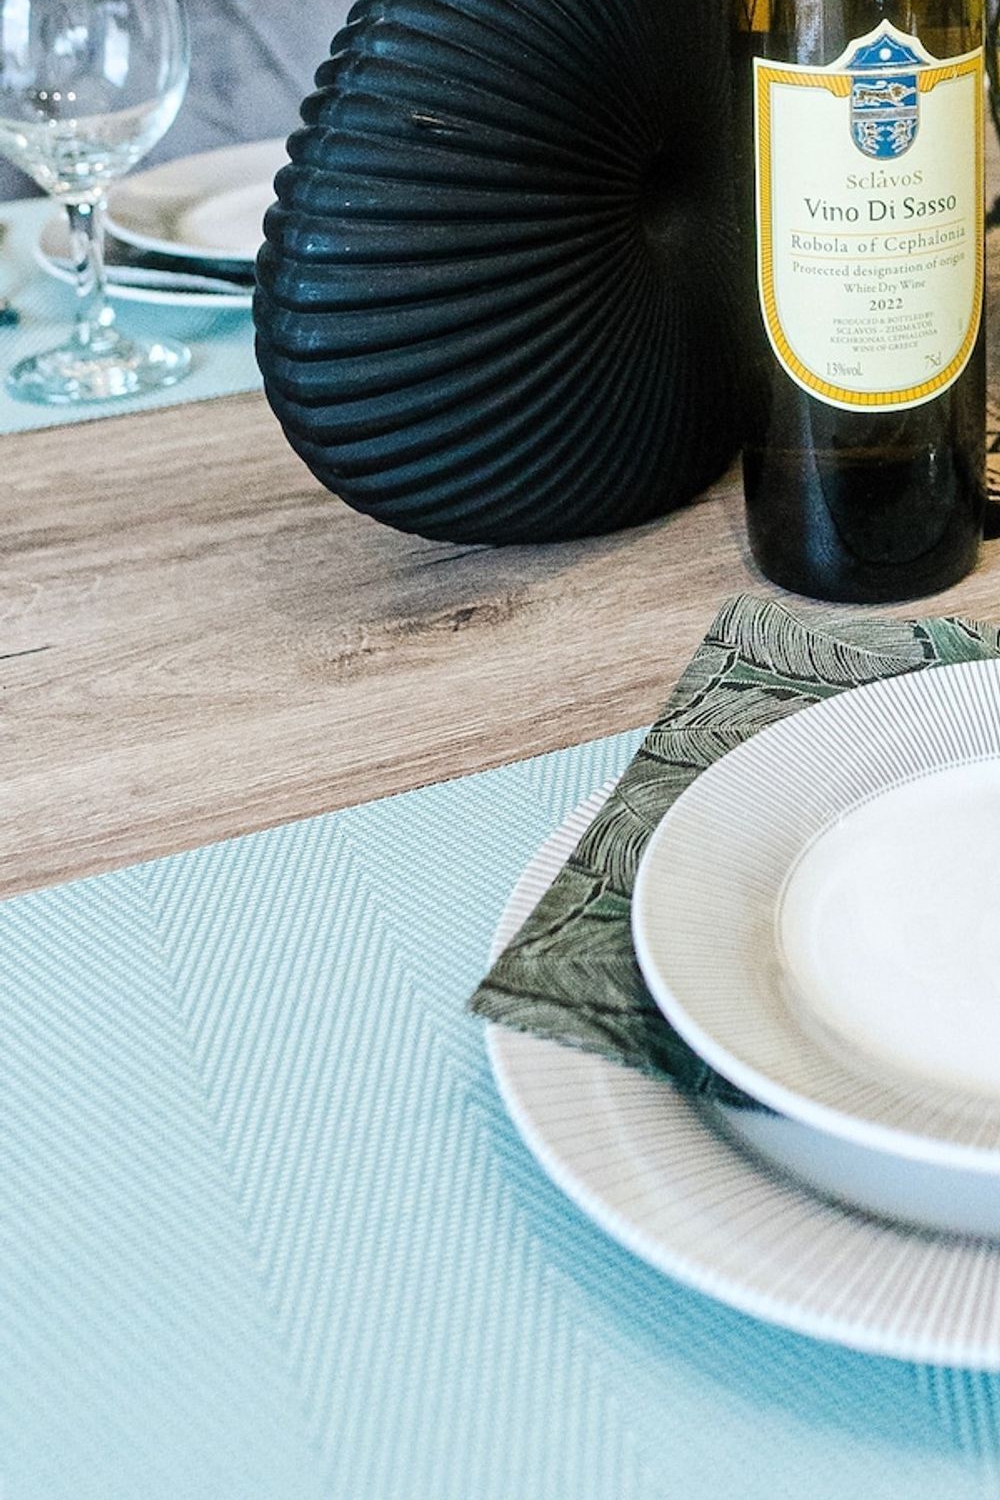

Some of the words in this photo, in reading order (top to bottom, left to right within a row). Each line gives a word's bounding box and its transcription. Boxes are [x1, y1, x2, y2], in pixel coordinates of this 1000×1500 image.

[803, 198, 859, 222] Vino
[868, 200, 895, 222] Di
[903, 194, 957, 219] Sasso
[790, 233, 848, 253] Robola
[857, 236, 879, 253] of
[884, 227, 966, 254] Cephalonia
[792, 261, 850, 277] Protected
[853, 261, 924, 279] designation
[926, 258, 938, 271] of
[843, 282, 877, 294] White
[878, 281, 897, 294] Dry
[900, 278, 926, 290] Wine
[869, 298, 904, 311] 2022
